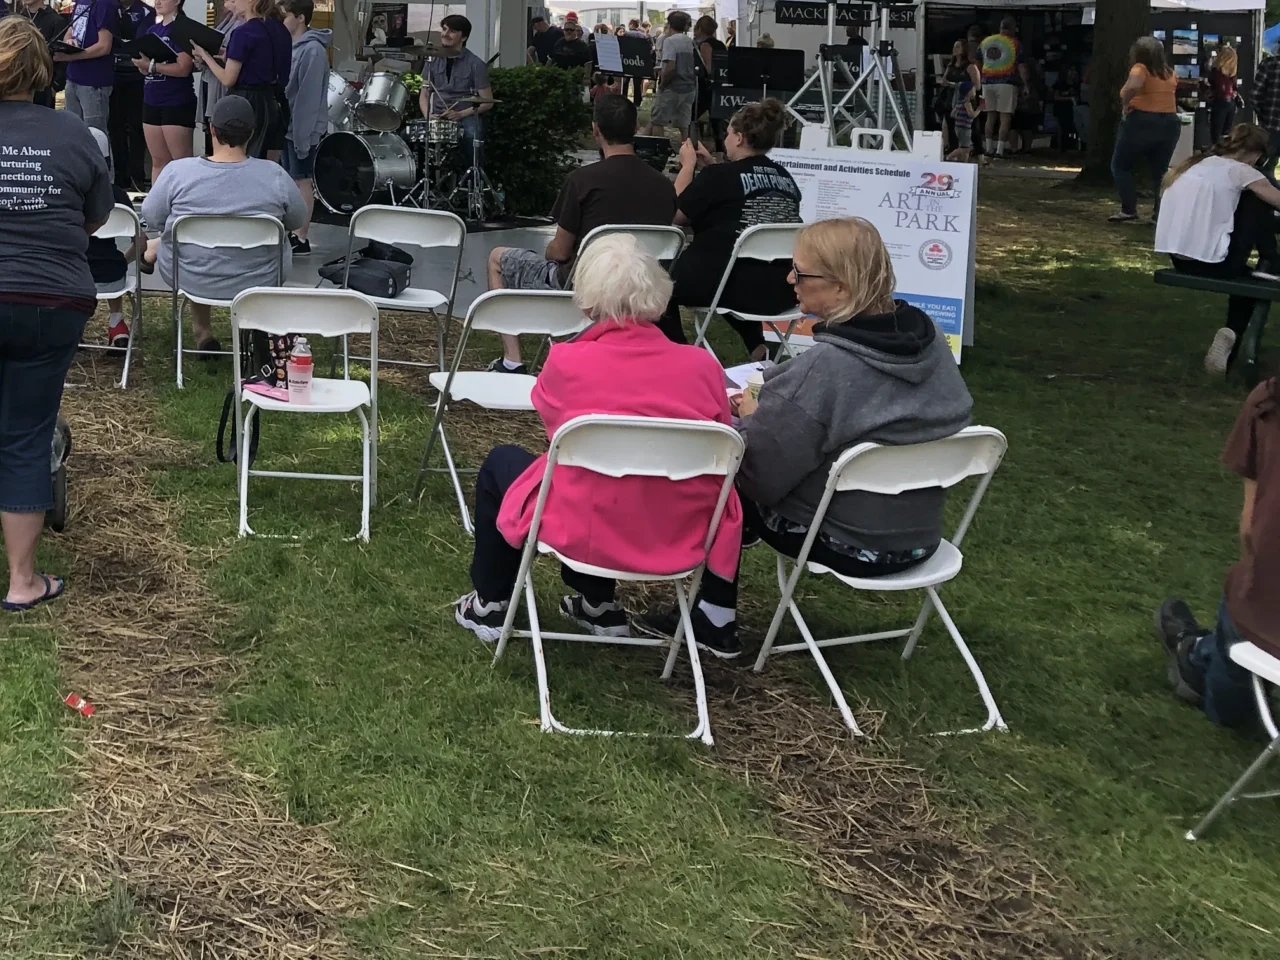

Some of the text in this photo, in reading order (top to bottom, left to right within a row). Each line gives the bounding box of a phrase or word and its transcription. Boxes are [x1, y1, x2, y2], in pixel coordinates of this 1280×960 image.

[780, 6, 859, 21] MACKIAC
[620, 54, 645, 67] oods
[1, 146, 19, 156] Me
[20, 146, 52, 157] About
[43, 173, 54, 182] to
[823, 163, 838, 172] and
[839, 165, 874, 175] Activities
[875, 167, 911, 178] Schedule
[47, 185, 62, 195] for
[740, 172, 771, 196] DEATH
[920, 189, 951, 197] ANNUAL
[878, 192, 927, 211] ART
[894, 210, 961, 233] PARK
